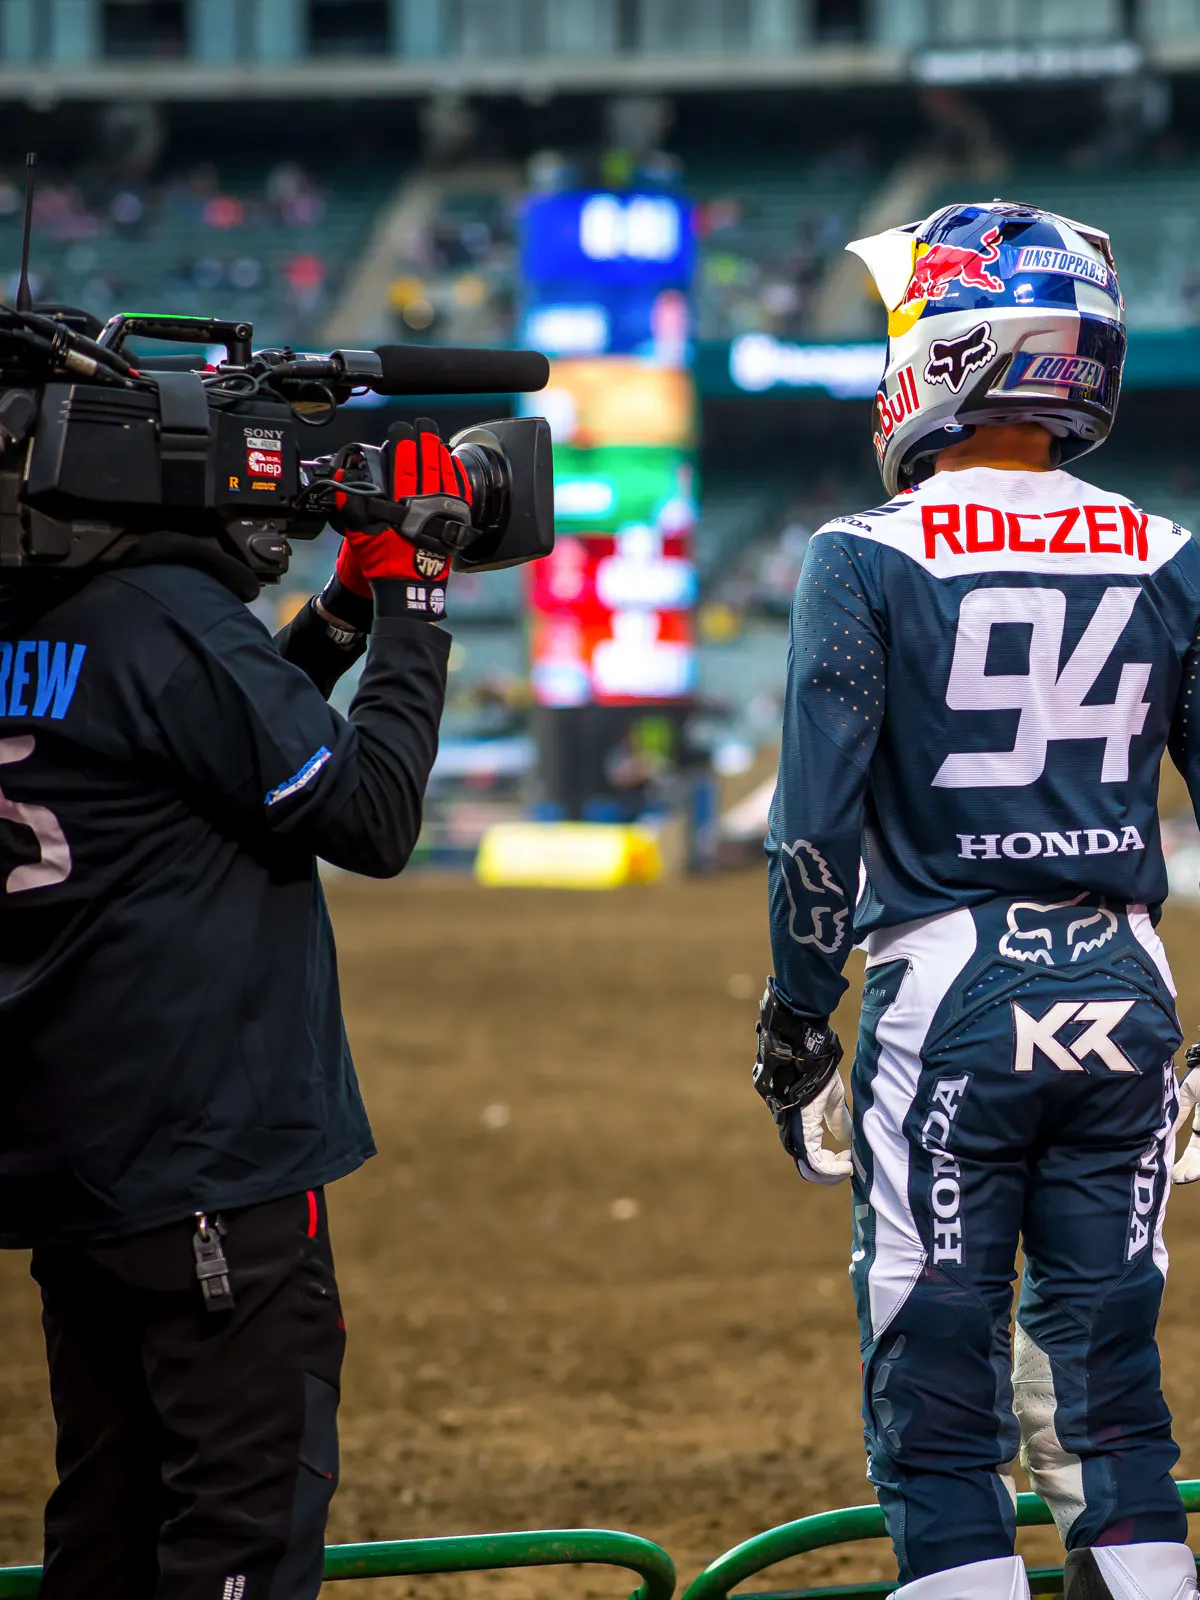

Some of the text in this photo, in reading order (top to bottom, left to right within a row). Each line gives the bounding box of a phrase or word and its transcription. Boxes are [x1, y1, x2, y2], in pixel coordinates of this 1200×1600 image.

[1022, 249, 1106, 285] UNSTOPPABLE
[1031, 356, 1102, 386] ROCZEN
[877, 365, 920, 438] Bull
[243, 427, 285, 439] SONY
[260, 462, 282, 476] nep
[921, 504, 1149, 562] ROCZEN
[0, 640, 88, 720] REW
[931, 586, 1153, 788] 94
[956, 825, 1146, 861] HONDA
[922, 1075, 970, 1265] HONDA
